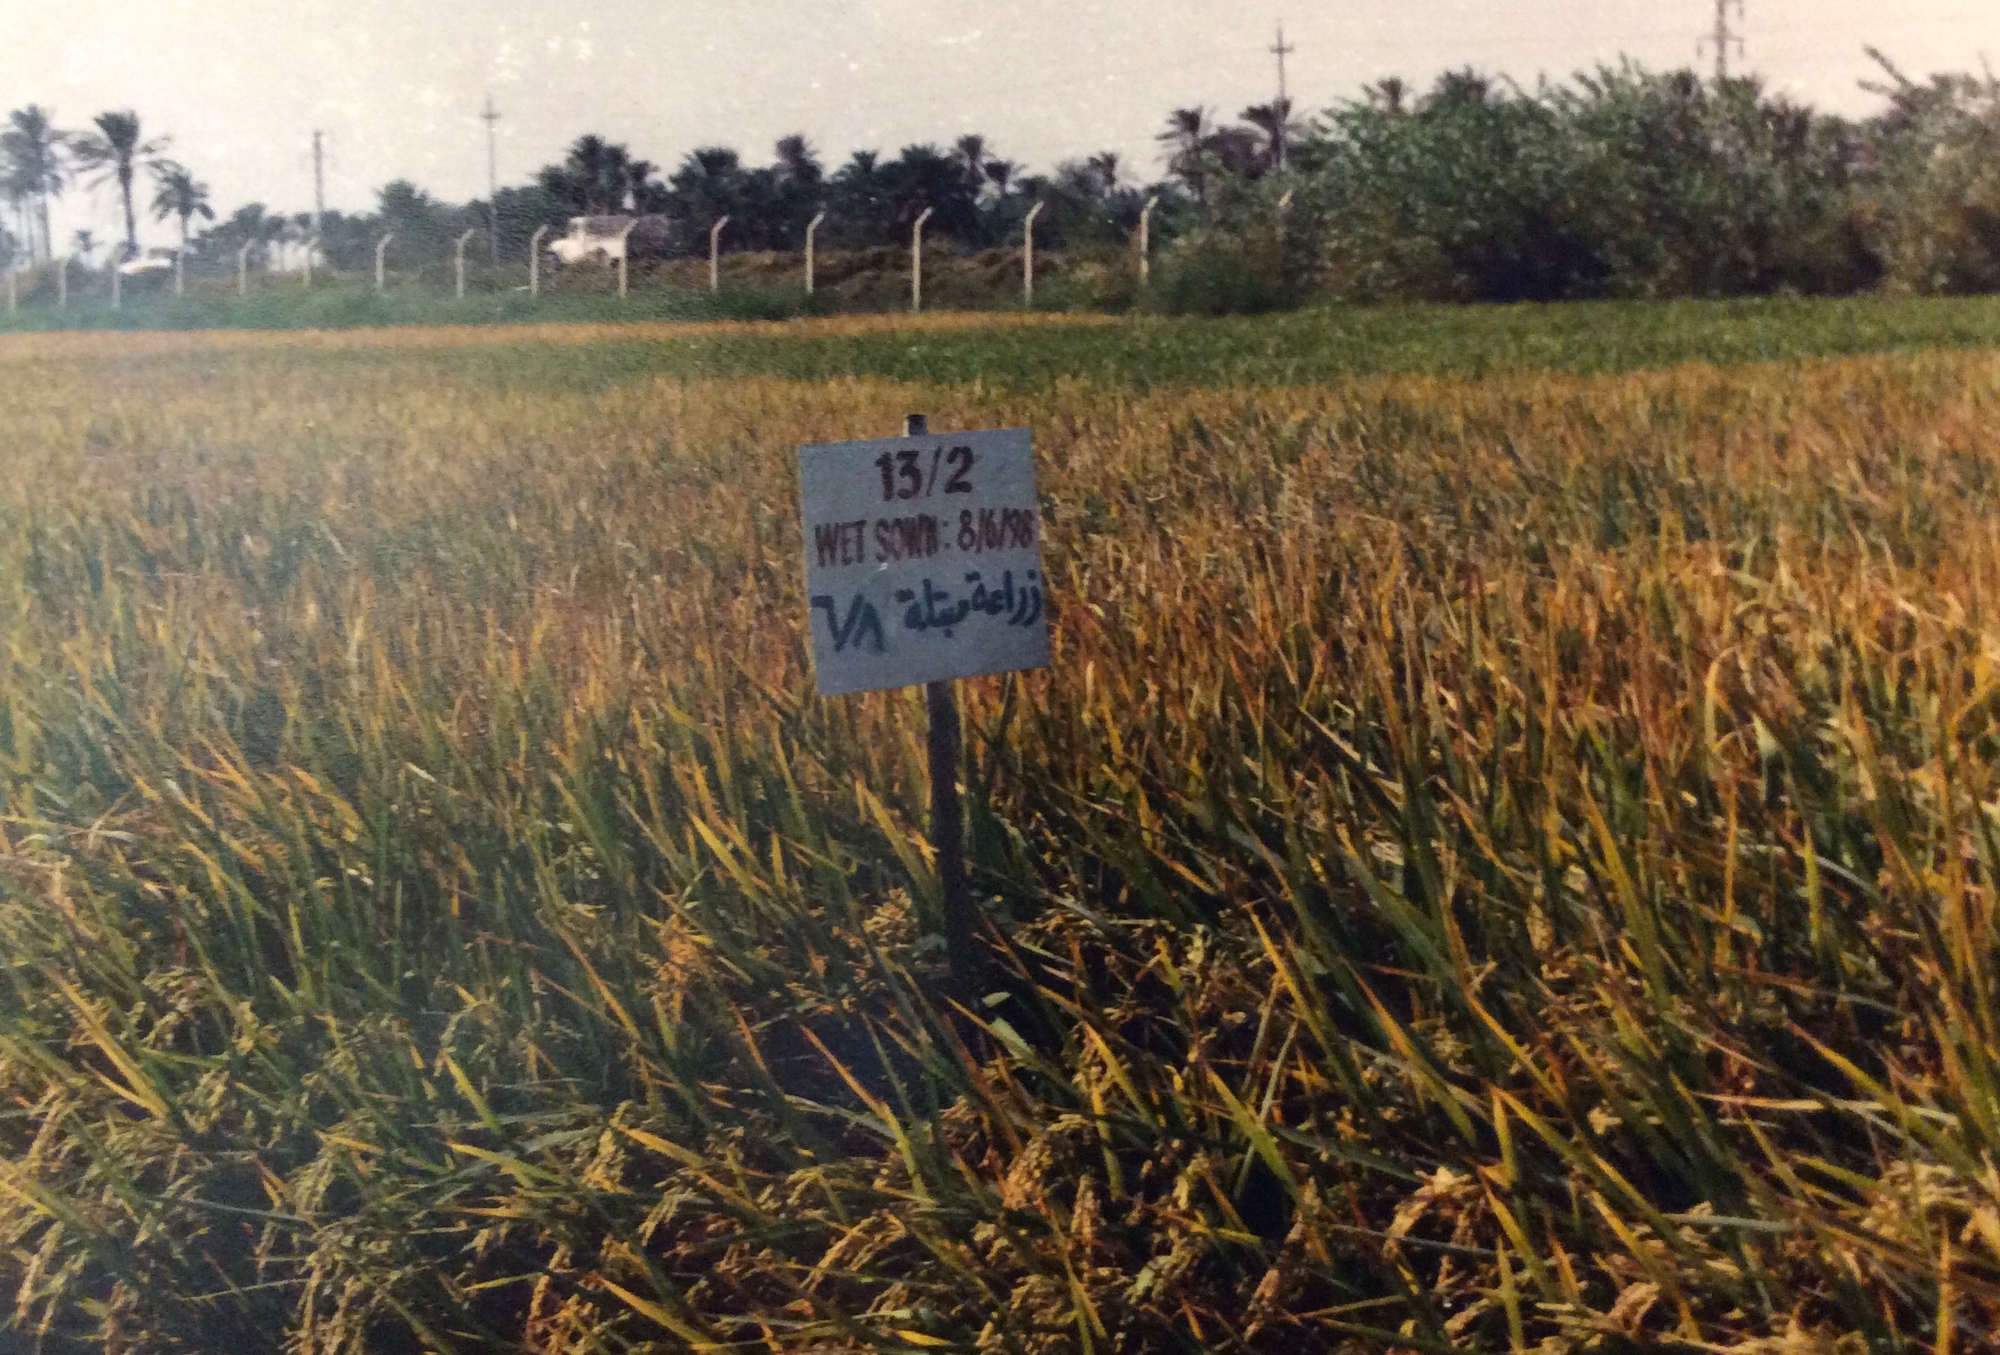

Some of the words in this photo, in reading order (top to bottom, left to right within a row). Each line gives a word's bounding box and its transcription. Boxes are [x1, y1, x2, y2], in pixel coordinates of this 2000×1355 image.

[875, 445, 974, 501] 13/2
[814, 519, 867, 567] WET
[964, 569, 1042, 628] زراعة
